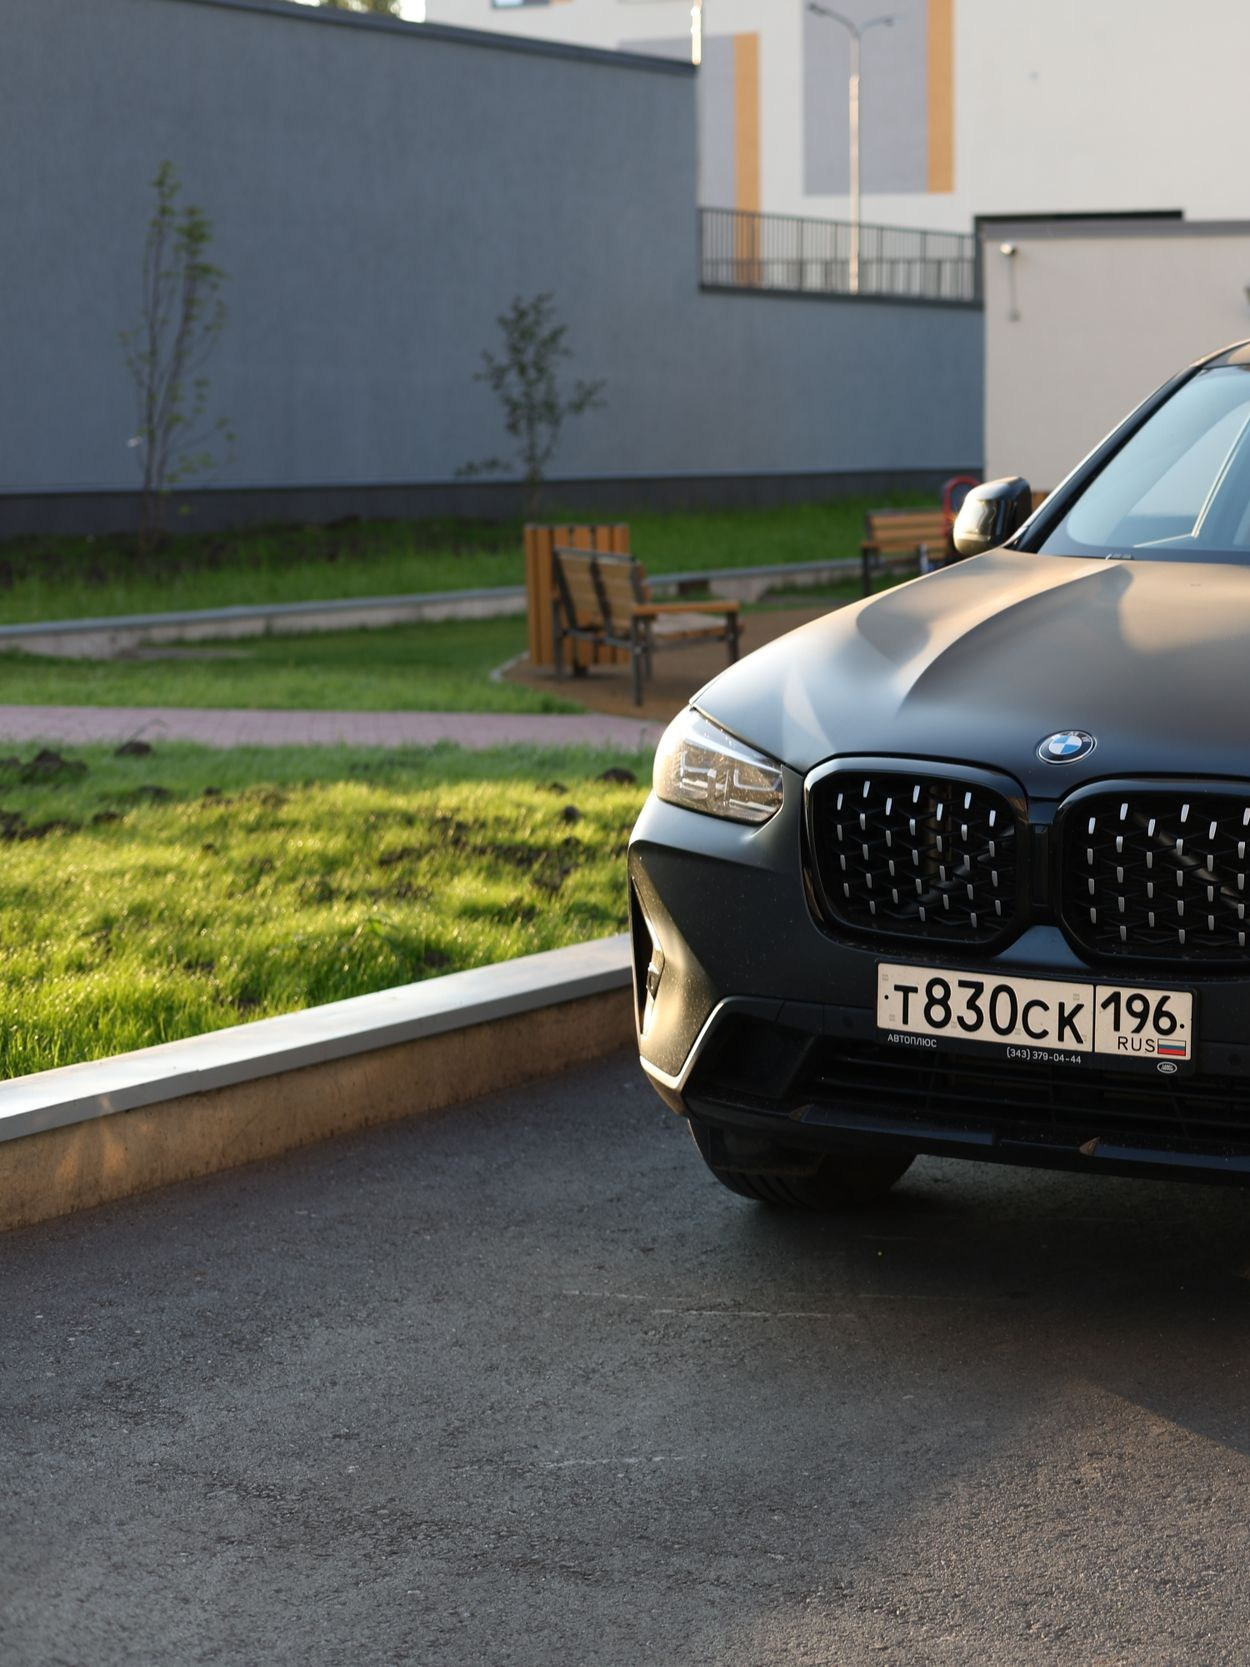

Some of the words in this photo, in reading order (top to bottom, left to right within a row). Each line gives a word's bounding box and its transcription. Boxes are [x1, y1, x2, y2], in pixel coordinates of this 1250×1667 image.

[893, 977, 1085, 1045] Т830СК
[1100, 990, 1178, 1036] 196
[887, 1033, 937, 1048] АВТОПЛЮС
[1117, 1036, 1156, 1053] RUS
[1006, 1046, 1031, 1060] (343)
[1032, 1050, 1082, 1064] 379-04-44
